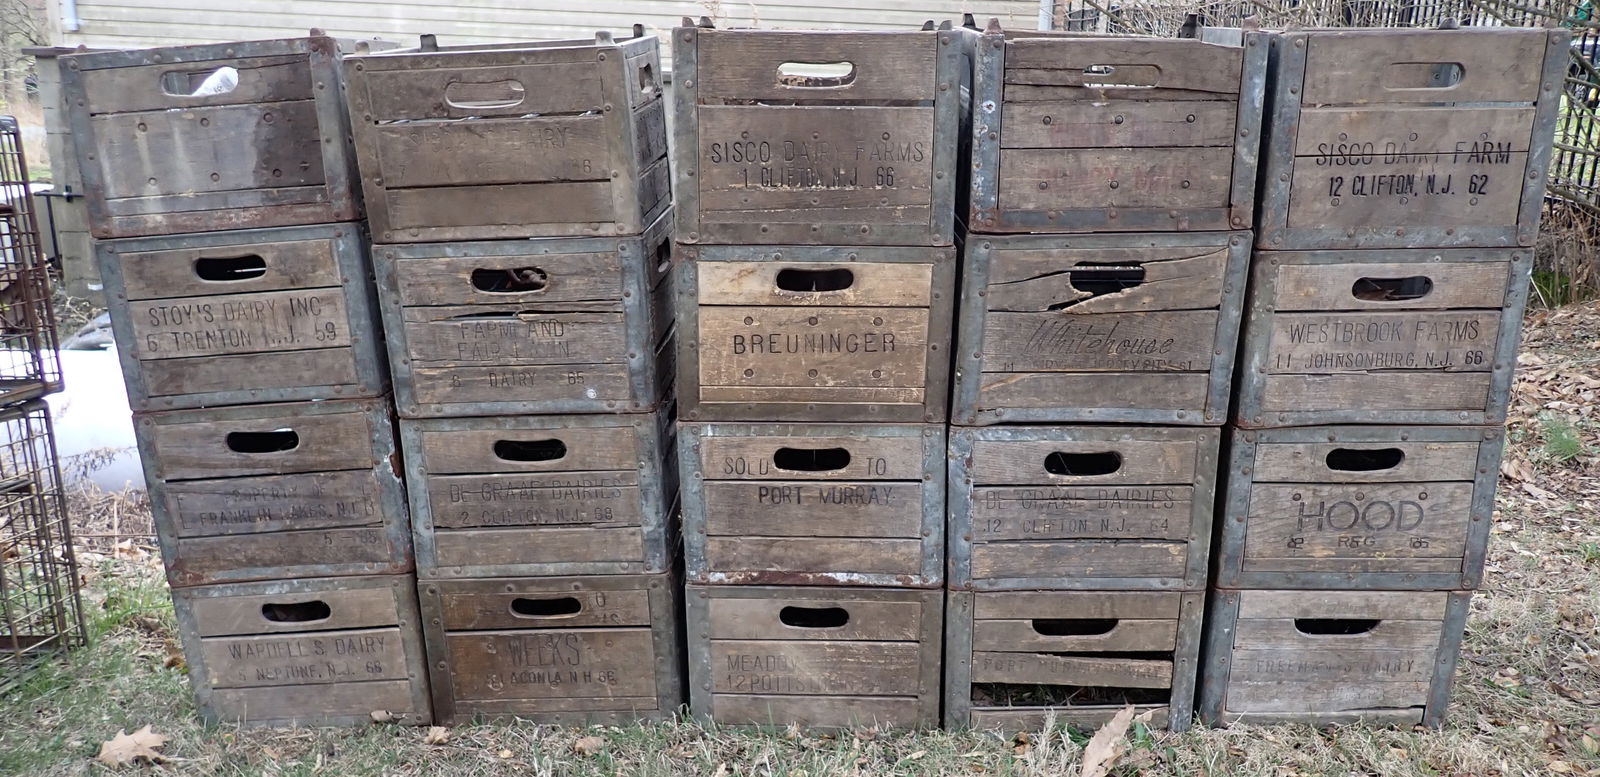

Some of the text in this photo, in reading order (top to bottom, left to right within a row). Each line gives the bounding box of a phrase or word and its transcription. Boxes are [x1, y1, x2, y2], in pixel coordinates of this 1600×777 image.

[711, 141, 771, 163] SISCO
[855, 140, 924, 162] FARMS
[1316, 142, 1374, 167] SISCO
[1453, 141, 1511, 165] FARM
[877, 166, 894, 187] 66
[1328, 175, 1344, 197] 12
[1425, 174, 1456, 196] N.J.
[1468, 174, 1490, 195] 62
[147, 296, 322, 327] STOY'S DAIRY INC
[146, 332, 158, 353] 6
[169, 325, 253, 351] TRENTON
[314, 321, 338, 342] 59
[1290, 319, 1480, 344] WESTBROOK FARMS
[733, 332, 896, 355] BREUNINGER
[1425, 351, 1453, 367] N.J.
[1464, 350, 1484, 366] 66
[488, 371, 537, 388] DAIRY
[567, 370, 586, 385] 65
[866, 456, 887, 476] TO
[551, 478, 623, 501] DAIRIES
[758, 485, 894, 506] PORT MURRAY
[1097, 488, 1175, 511] DAIRIES
[555, 507, 584, 523] N.J.
[1296, 500, 1425, 532] HOOD
[335, 637, 386, 656] DAIRY
[508, 632, 581, 667] WEEKS
